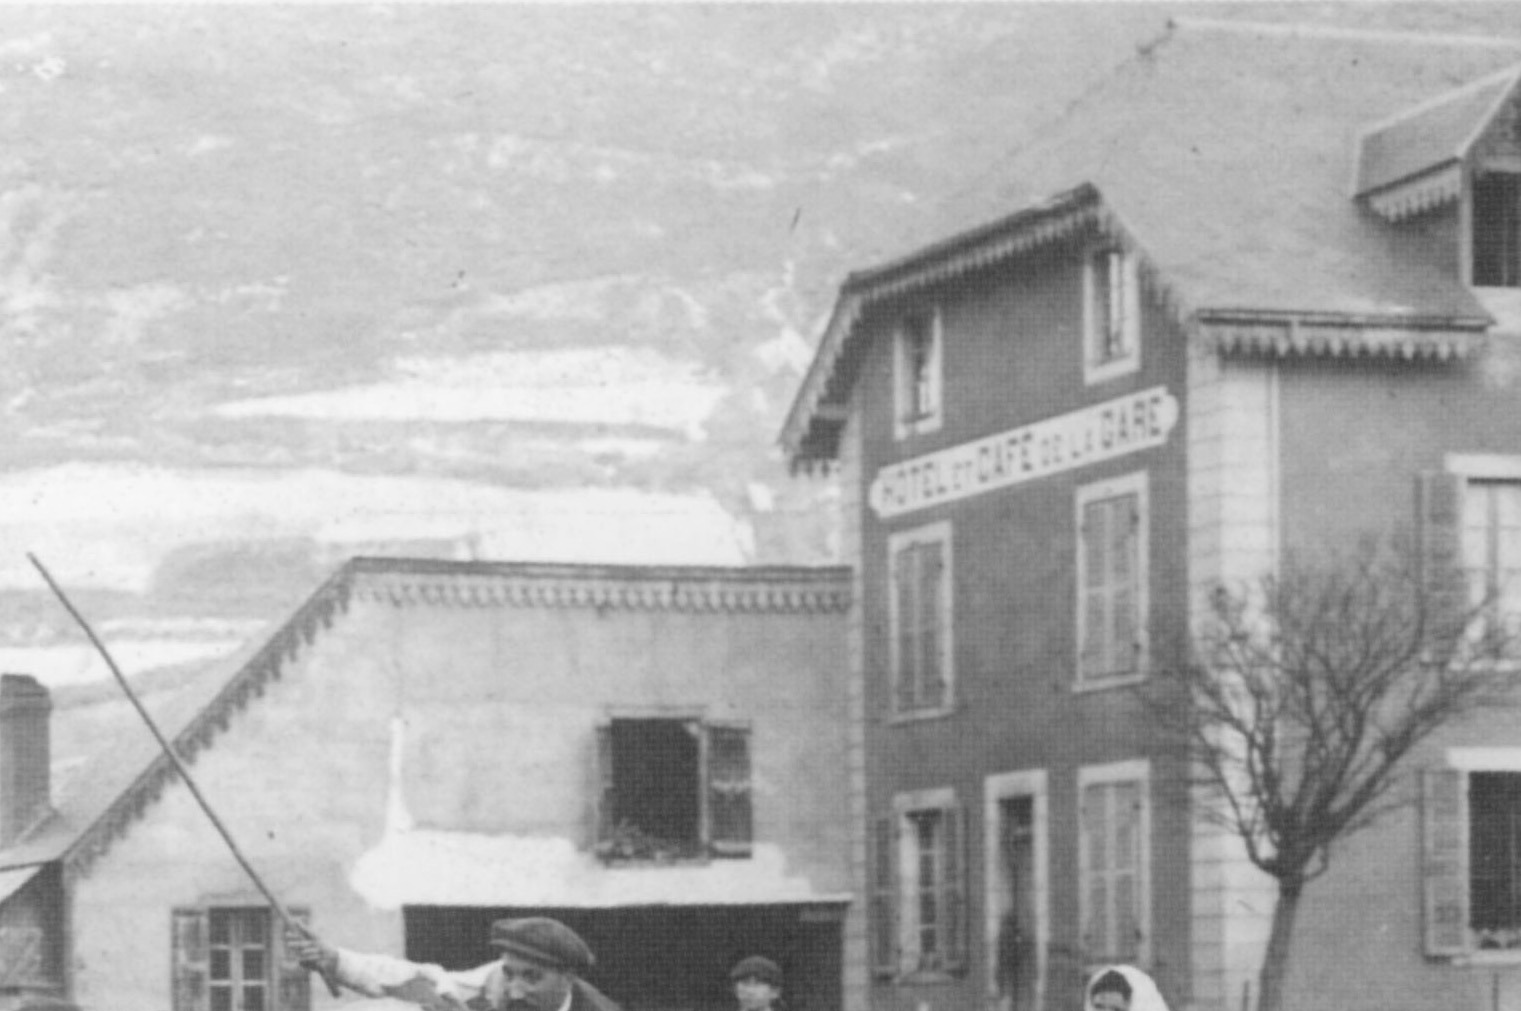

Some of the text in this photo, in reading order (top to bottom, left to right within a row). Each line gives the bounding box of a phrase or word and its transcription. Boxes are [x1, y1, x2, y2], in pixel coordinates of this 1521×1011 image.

[1041, 433, 1064, 466] DE
[1068, 427, 1094, 459] LA
[1099, 394, 1163, 449] GARE
